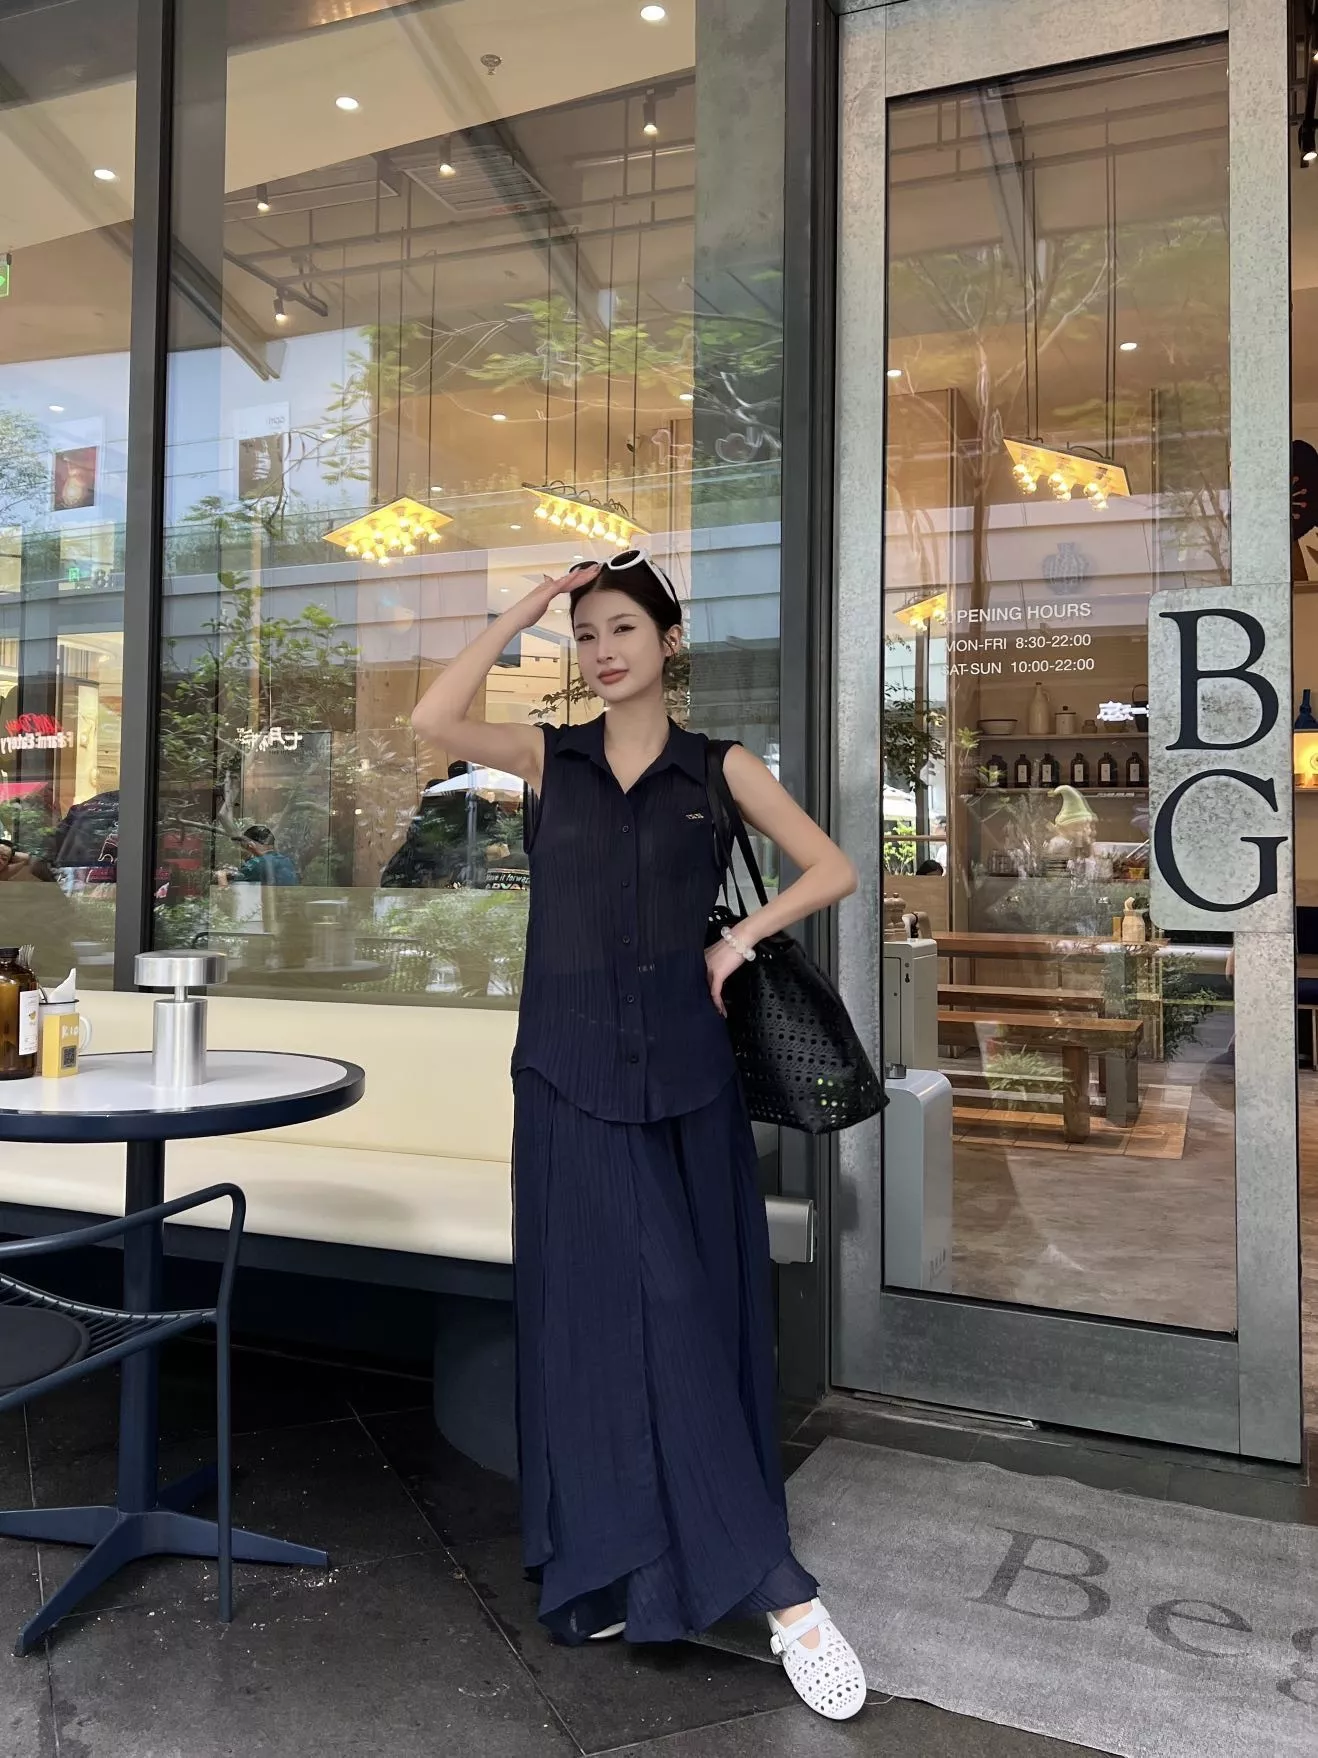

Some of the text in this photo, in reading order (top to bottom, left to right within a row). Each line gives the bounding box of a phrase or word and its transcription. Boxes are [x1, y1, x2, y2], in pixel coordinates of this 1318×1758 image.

[1027, 602, 1091, 620] HOURS
[944, 633, 1092, 652] MON-FRI 8:30-22:00
[940, 658, 1095, 676] SAT-SUN 10:00-22:00
